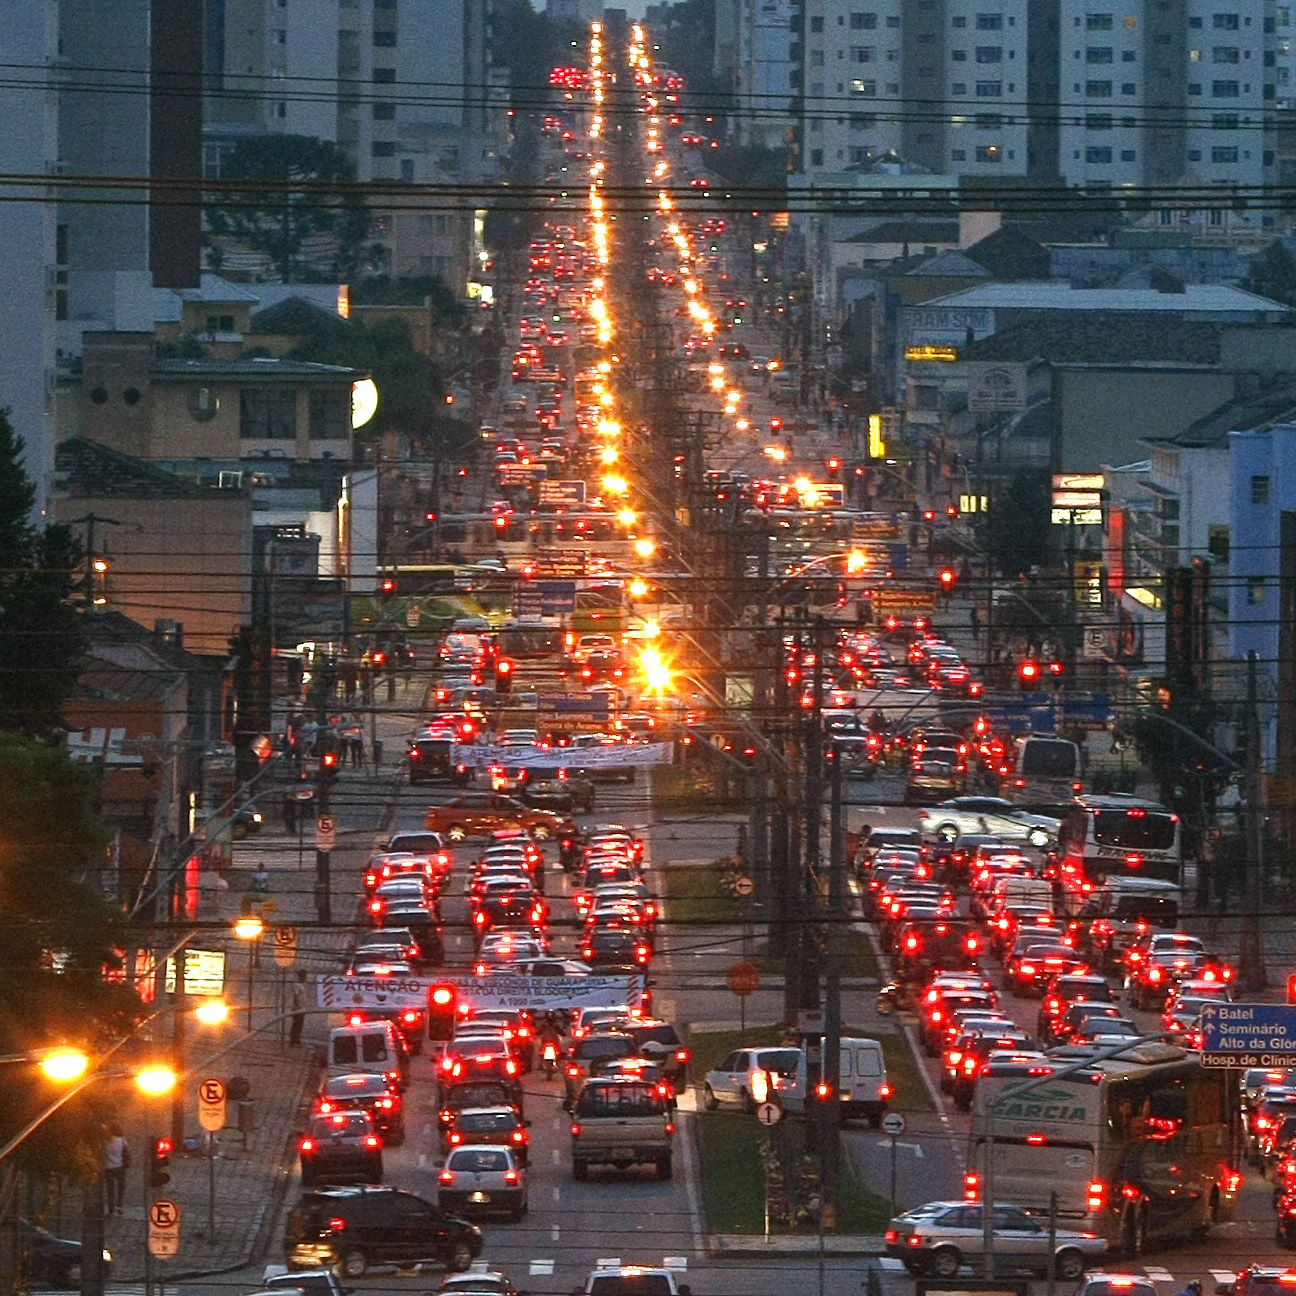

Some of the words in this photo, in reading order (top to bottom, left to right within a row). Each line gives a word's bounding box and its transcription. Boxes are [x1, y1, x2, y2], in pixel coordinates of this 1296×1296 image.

[345, 979, 420, 994] ATENÇÃO
[1219, 1008, 1254, 1020] Batel
[1219, 1024, 1287, 1035] Seminário
[1219, 1038, 1245, 1049] Alto
[1249, 1038, 1266, 1049] da
[1203, 1055, 1239, 1067] Hosp.
[1240, 1055, 1257, 1066] de
